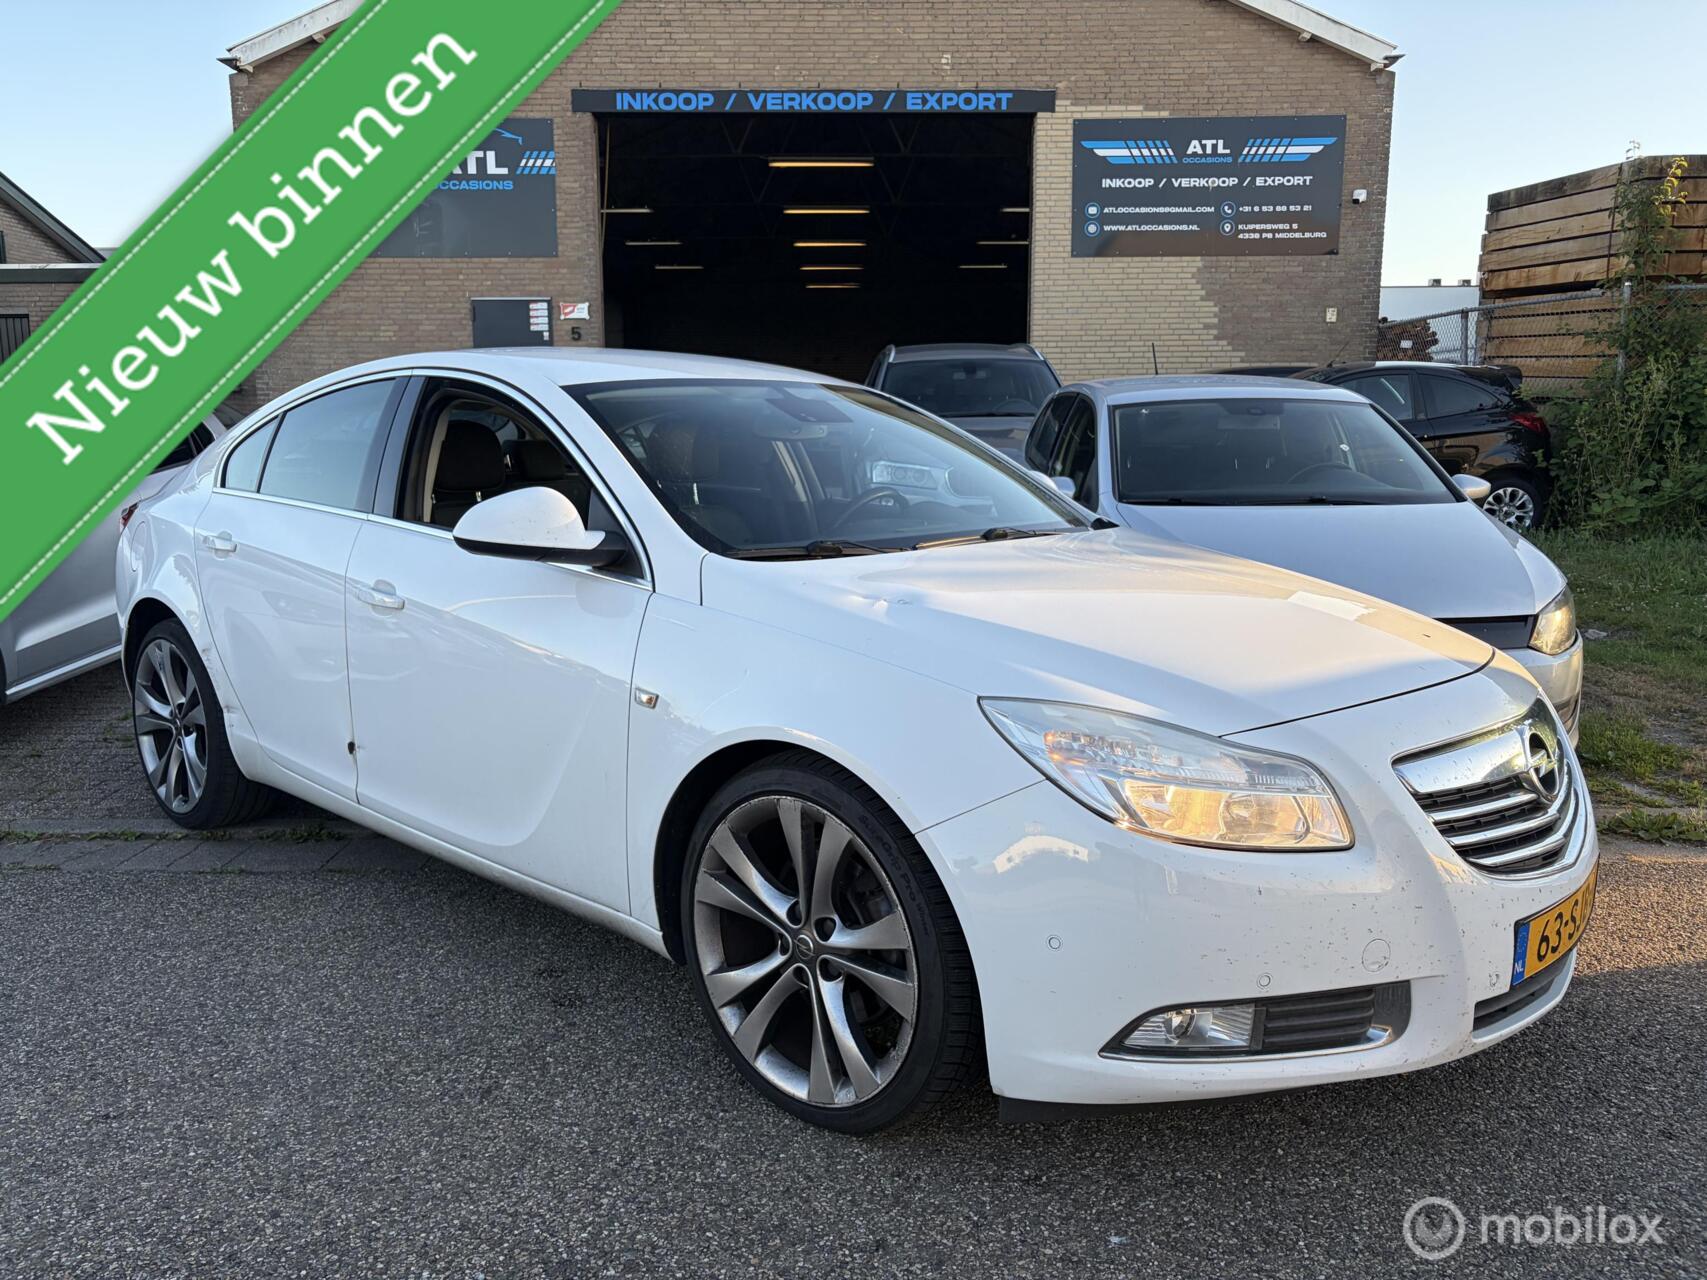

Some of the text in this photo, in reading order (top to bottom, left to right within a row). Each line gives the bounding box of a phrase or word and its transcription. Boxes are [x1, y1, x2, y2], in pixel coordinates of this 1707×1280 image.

[615, 92, 714, 110] INKOOP
[748, 92, 874, 110] VERKOOP
[906, 92, 1013, 110] EXPORT
[1186, 139, 1231, 154] ATL
[436, 180, 514, 190] CCASIONS
[1101, 178, 1154, 188] INKOOP
[1171, 176, 1239, 188] VERKOOP
[1255, 175, 1314, 187] EXPORT
[571, 326, 582, 341] 5
[1514, 960, 1523, 975] NL
